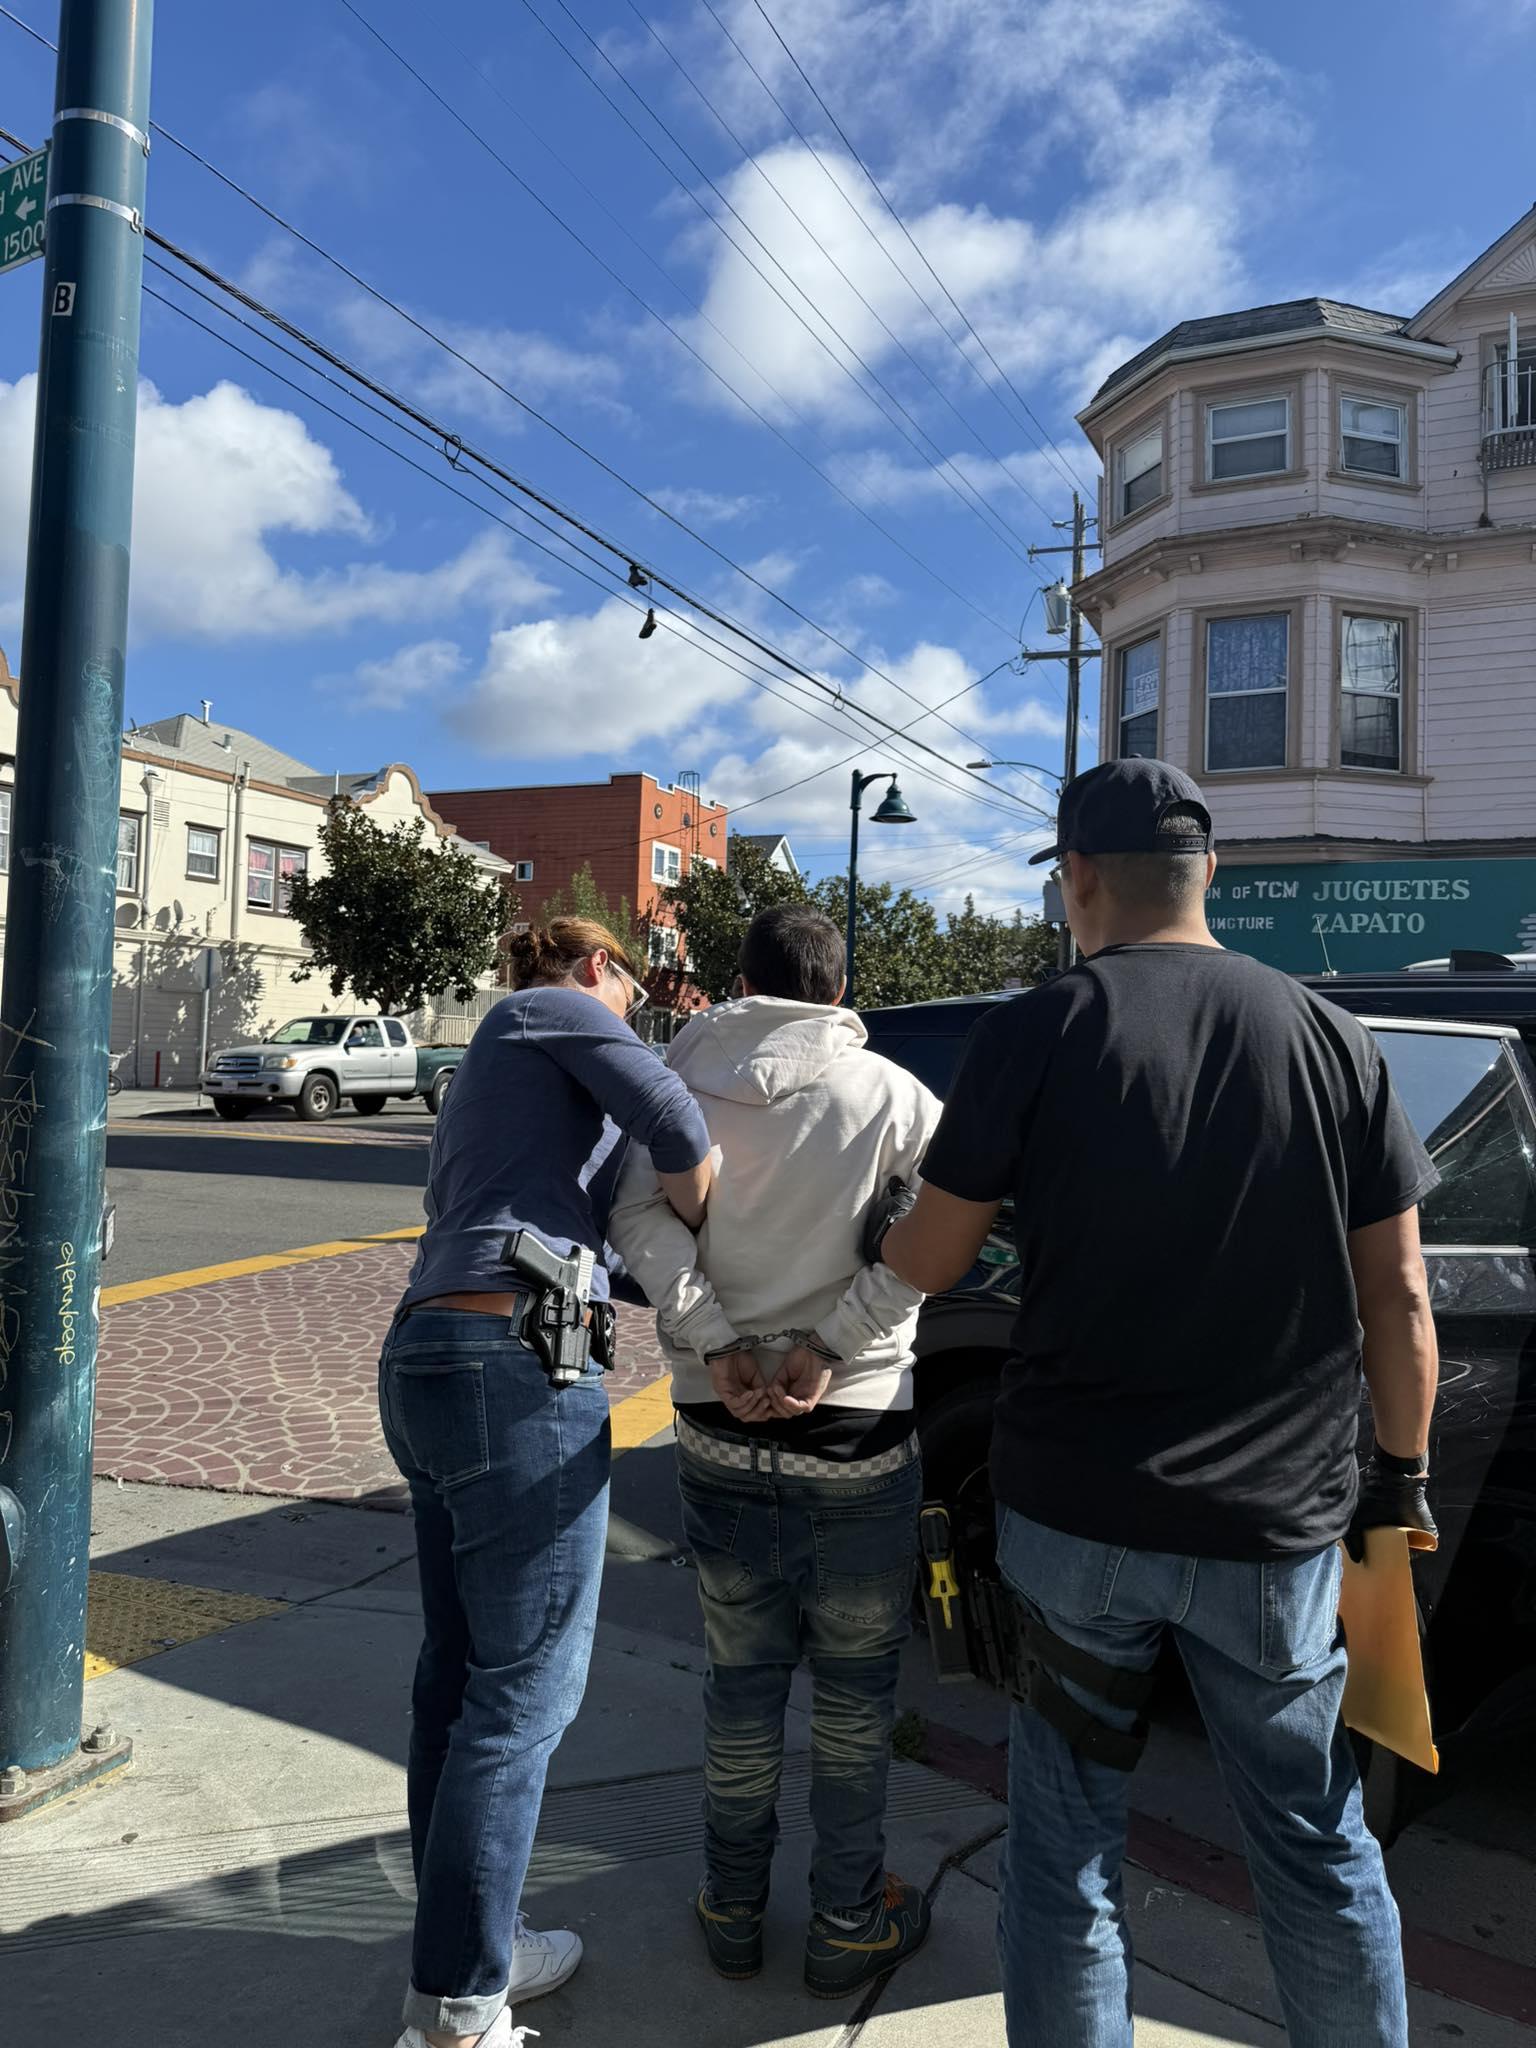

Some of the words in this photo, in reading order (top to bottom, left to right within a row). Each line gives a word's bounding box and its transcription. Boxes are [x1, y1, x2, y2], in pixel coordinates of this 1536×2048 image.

[10, 155, 45, 196] AVE
[3, 219, 46, 261] 1500
[54, 284, 72, 313] B
[1204, 887, 1221, 899] ON
[1231, 886, 1251, 899] OF
[1254, 880, 1299, 898] TCM
[1312, 879, 1471, 901] JUGUETES
[1207, 917, 1275, 930] UNCTURE
[1311, 912, 1426, 934] ZAPATO
